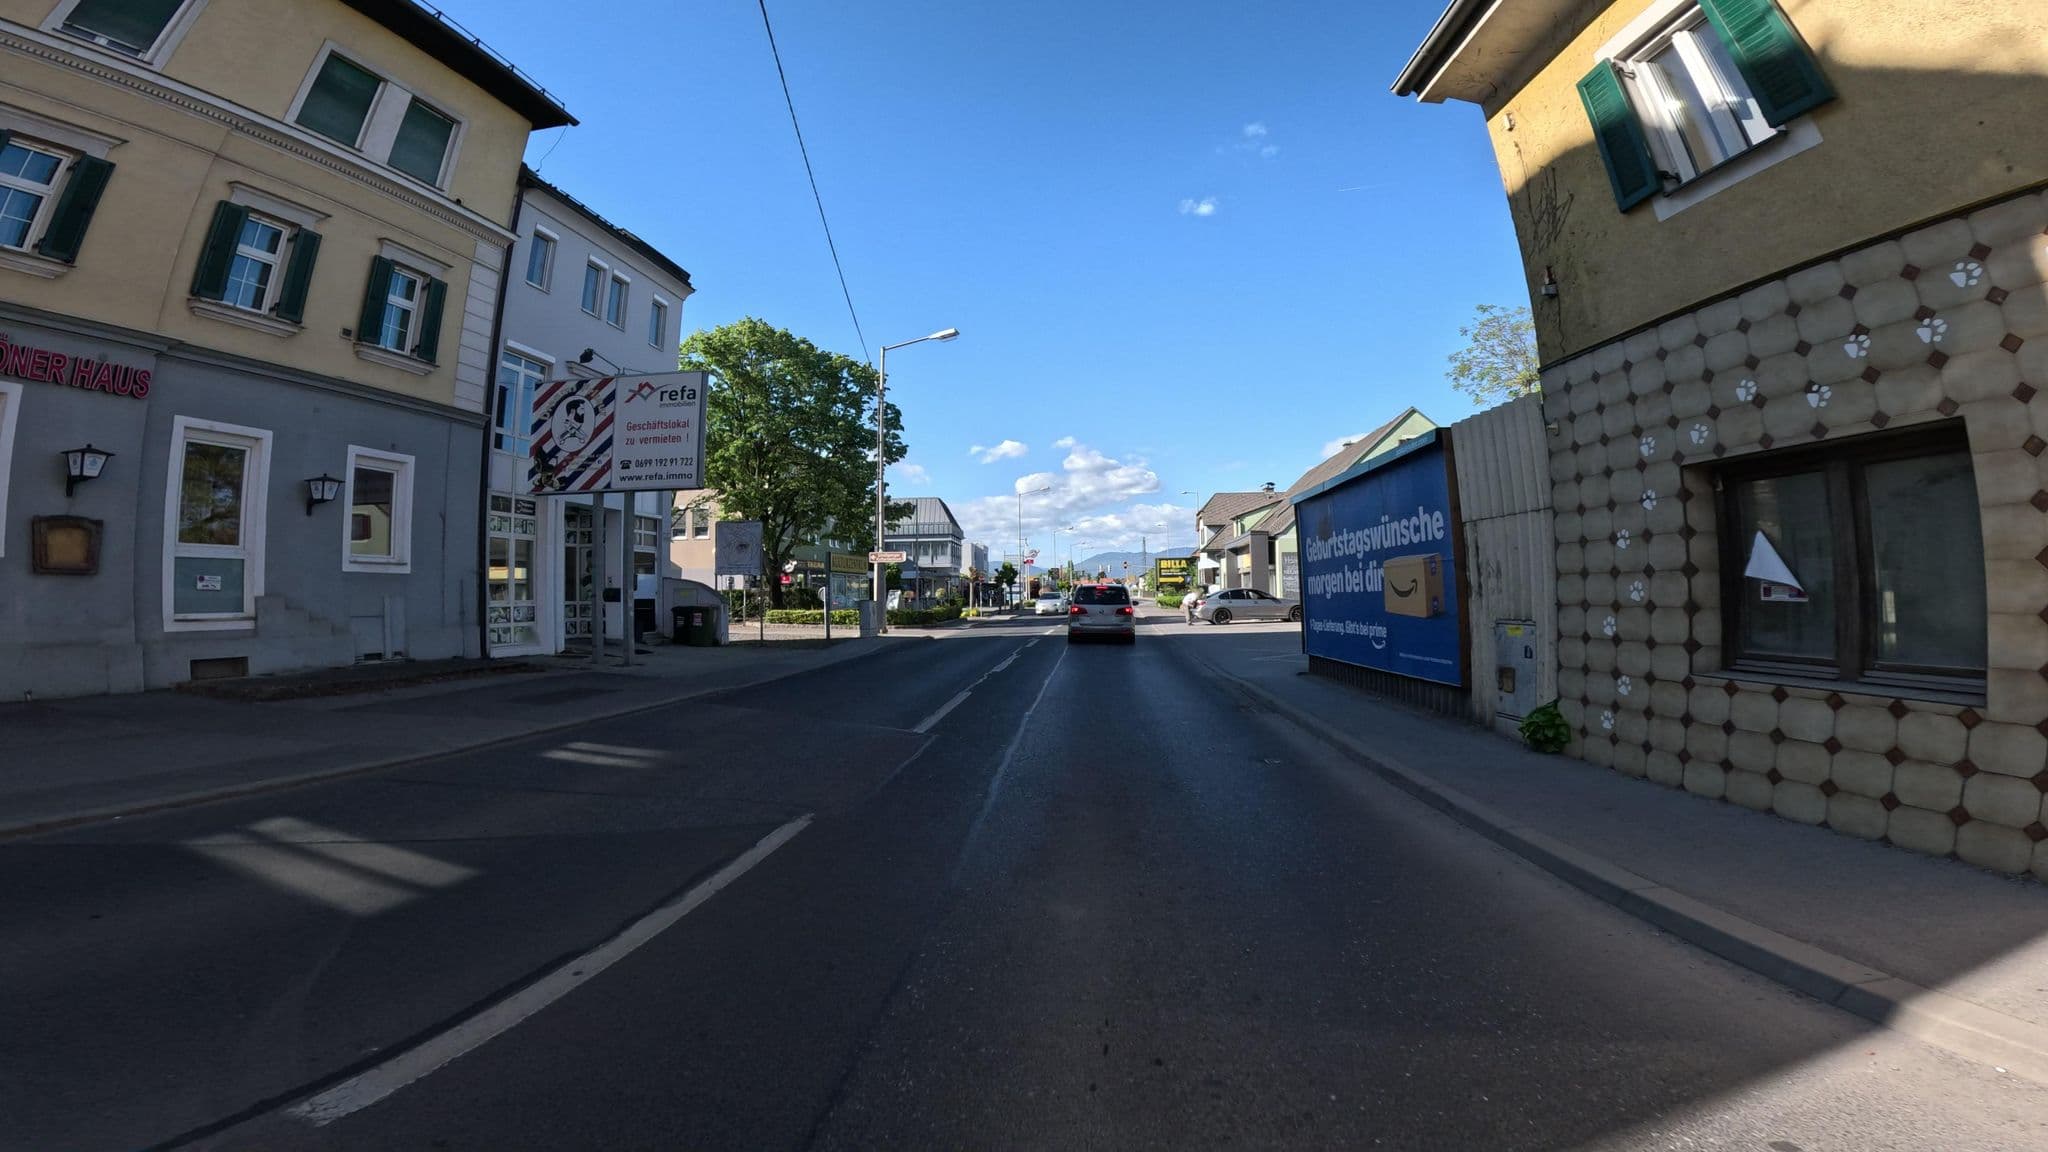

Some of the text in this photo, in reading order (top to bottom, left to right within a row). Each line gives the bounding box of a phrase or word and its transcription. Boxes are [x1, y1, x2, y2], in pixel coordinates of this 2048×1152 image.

[71, 357, 152, 399] HAUS
[659, 385, 697, 401] refa
[626, 420, 690, 431] Geschäftslokal
[625, 437, 635, 446] zu
[639, 434, 682, 445] vermieten
[635, 457, 693, 468] 0699 192 91 722
[620, 471, 693, 482] www.refa.immo
[1306, 506, 1445, 563] Geburtstagswünsche
[1160, 559, 1187, 568] BILLA
[1308, 572, 1344, 599] morgen
[1344, 562, 1364, 593] bei
[1365, 560, 1384, 592] dir
[1359, 621, 1369, 636] bei
[1369, 622, 1387, 639] prime
